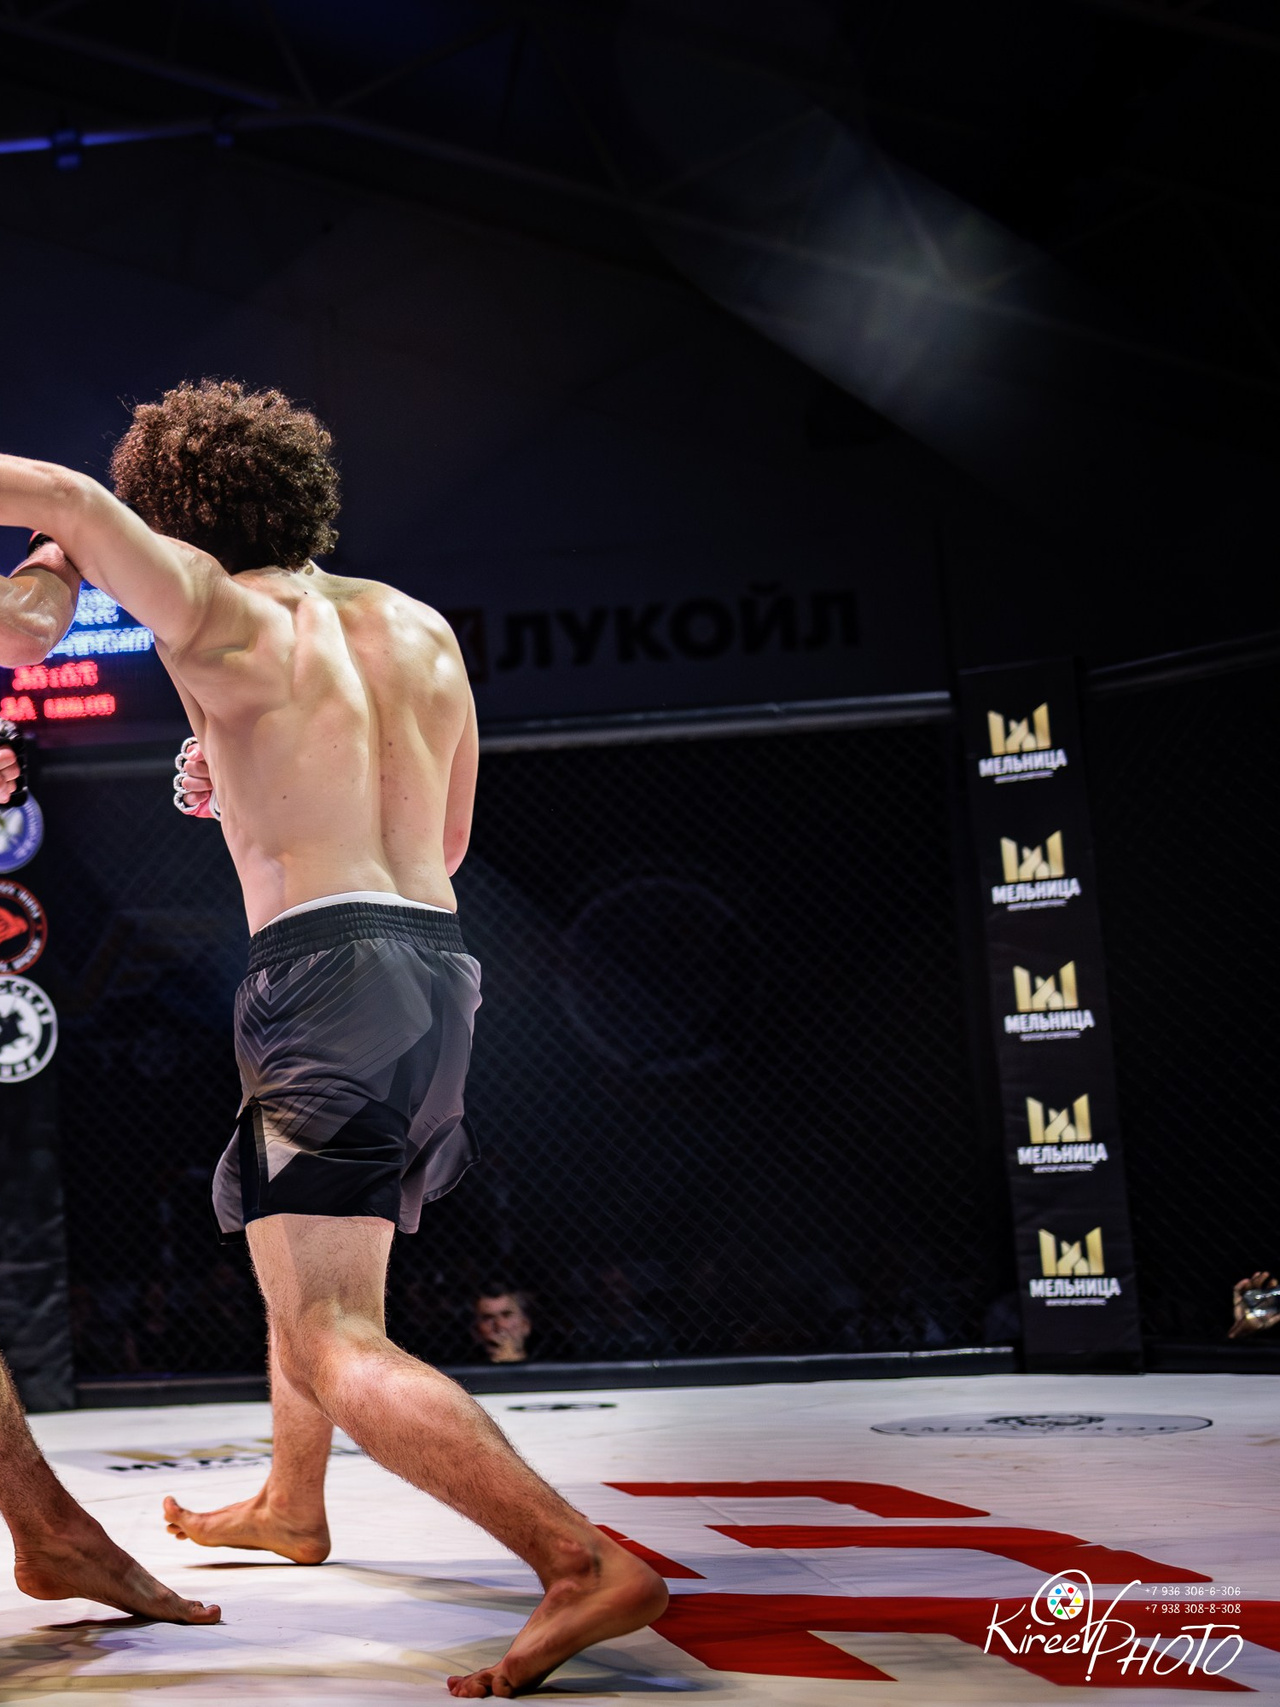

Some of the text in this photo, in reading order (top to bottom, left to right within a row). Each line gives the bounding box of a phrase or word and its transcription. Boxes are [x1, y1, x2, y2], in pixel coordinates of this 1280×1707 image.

[496, 581, 860, 671] ЛУКОЙЛ
[978, 748, 1068, 777] МЕЛЬНИЦА
[991, 878, 1081, 905] МЕЛЬНИЦА
[1004, 1009, 1095, 1034] МЕЛЬНИЦА
[1017, 1142, 1108, 1165] МЕЛЬНИЦА
[1029, 1277, 1122, 1300] МЕЛЬНИЦА
